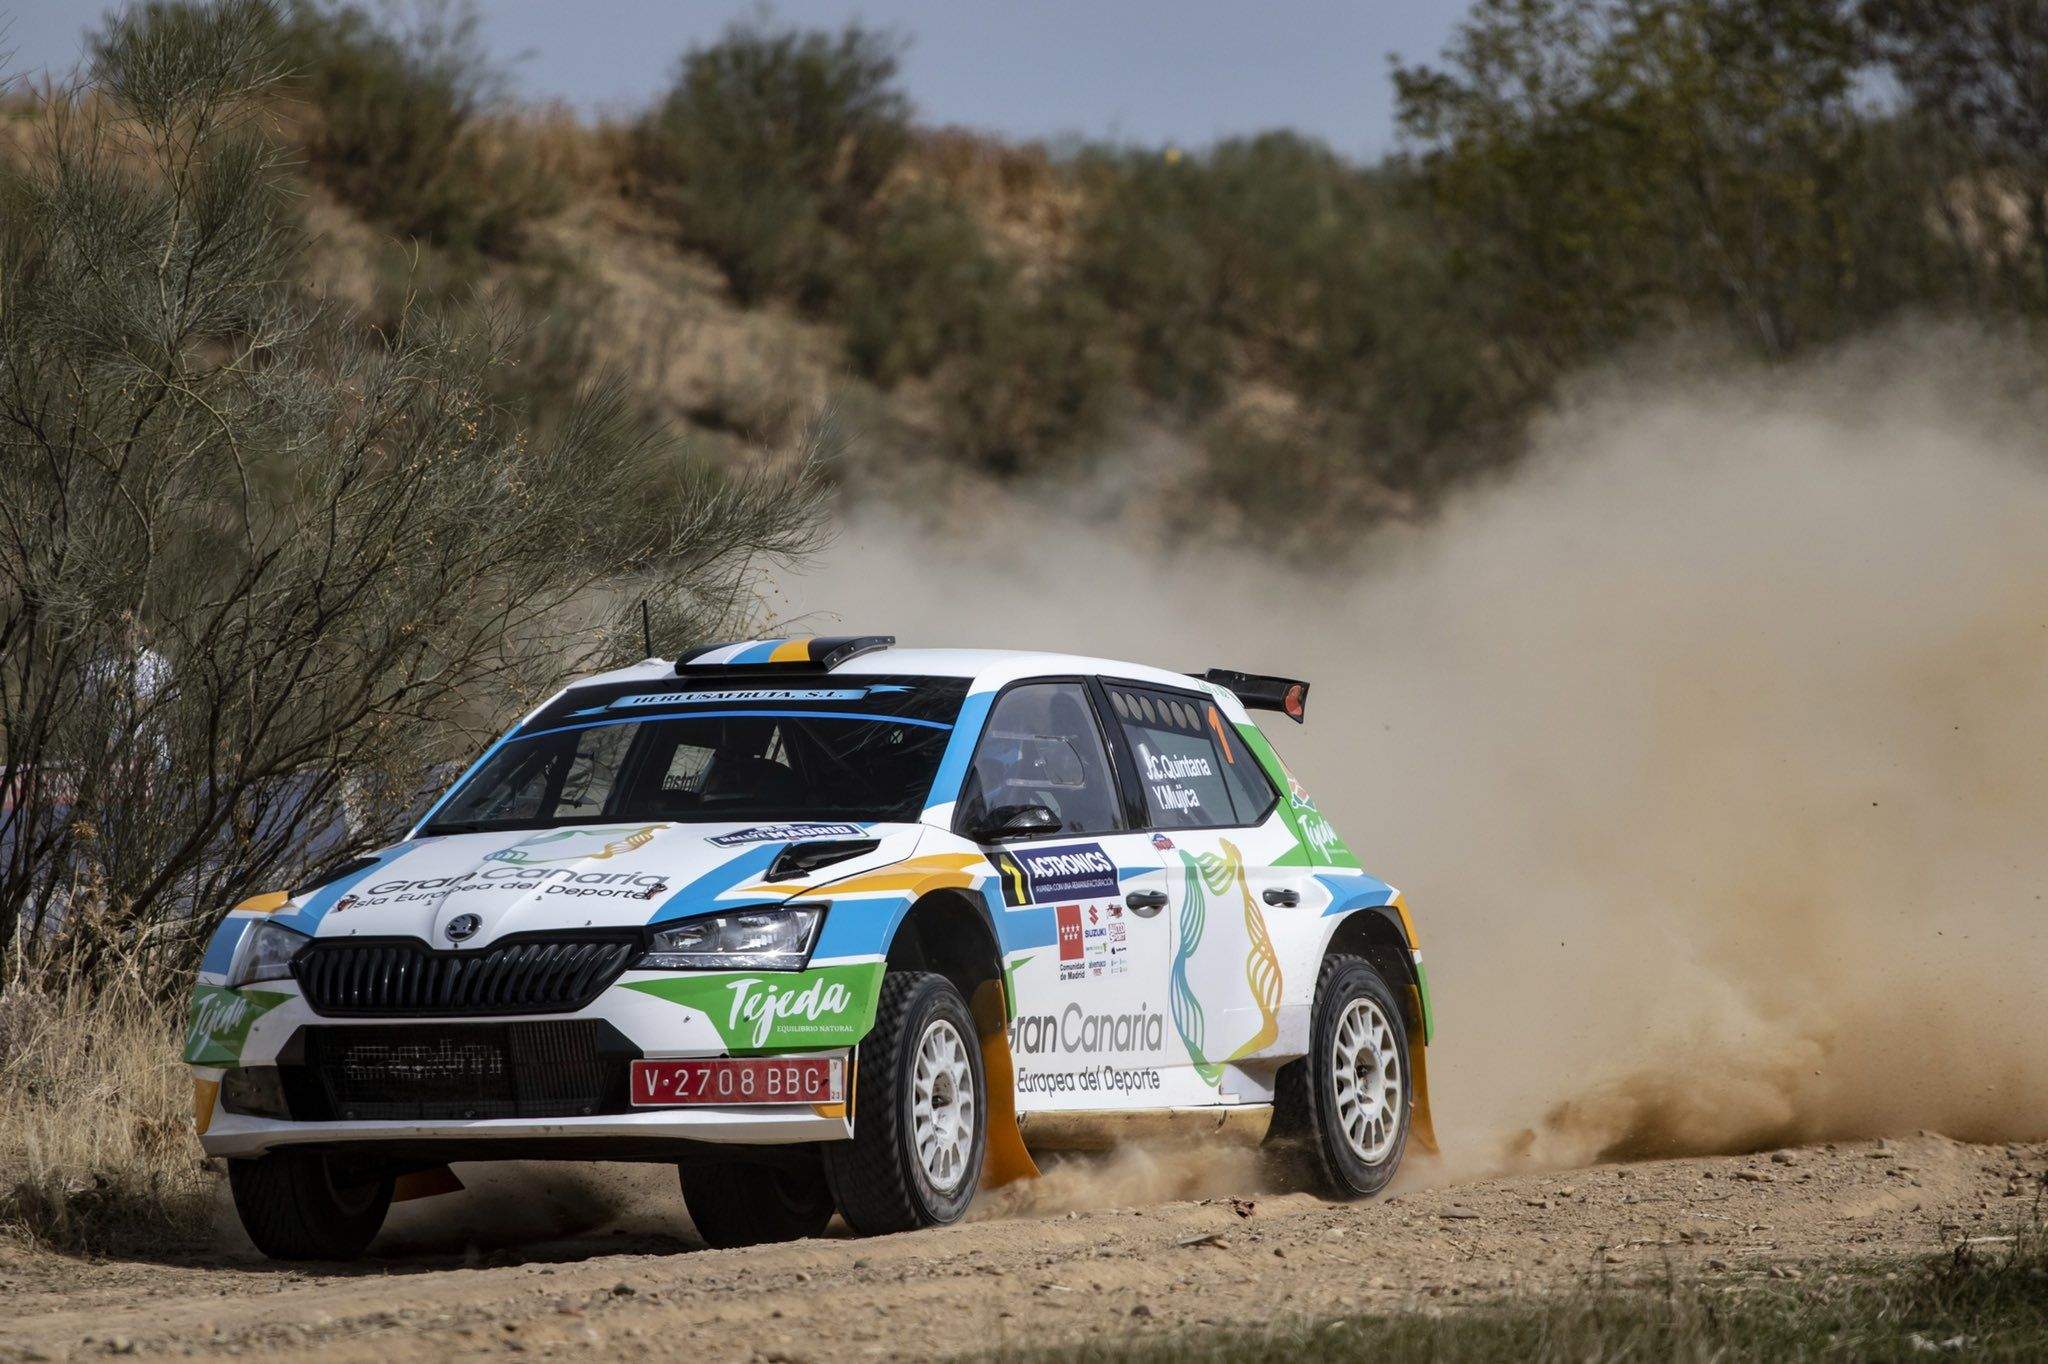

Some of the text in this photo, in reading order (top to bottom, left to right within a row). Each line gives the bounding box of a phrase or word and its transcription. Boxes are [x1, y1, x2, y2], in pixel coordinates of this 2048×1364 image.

[1207, 706, 1235, 764] 1
[767, 825, 853, 840] MADRID
[1028, 851, 1112, 878] ACTRONICS
[368, 866, 670, 896] Gran Canaria
[394, 882, 492, 904] Europea
[501, 881, 539, 890] del
[545, 884, 649, 900] Deporte
[1000, 854, 1027, 905] 1
[1085, 928, 1107, 938] SUZUKI
[1060, 962, 1085, 971] Comunidad
[1060, 973, 1066, 981] de
[1068, 970, 1085, 980] Madrid
[726, 978, 852, 1048] Tejeda
[1061, 1001, 1163, 1053] Canaria
[777, 1024, 854, 1033] EQUILIBRIO NATURAL
[674, 1069, 755, 1096] 2708
[767, 1067, 819, 1095] BBG
[1017, 1064, 1161, 1098] Europea del Deporte
